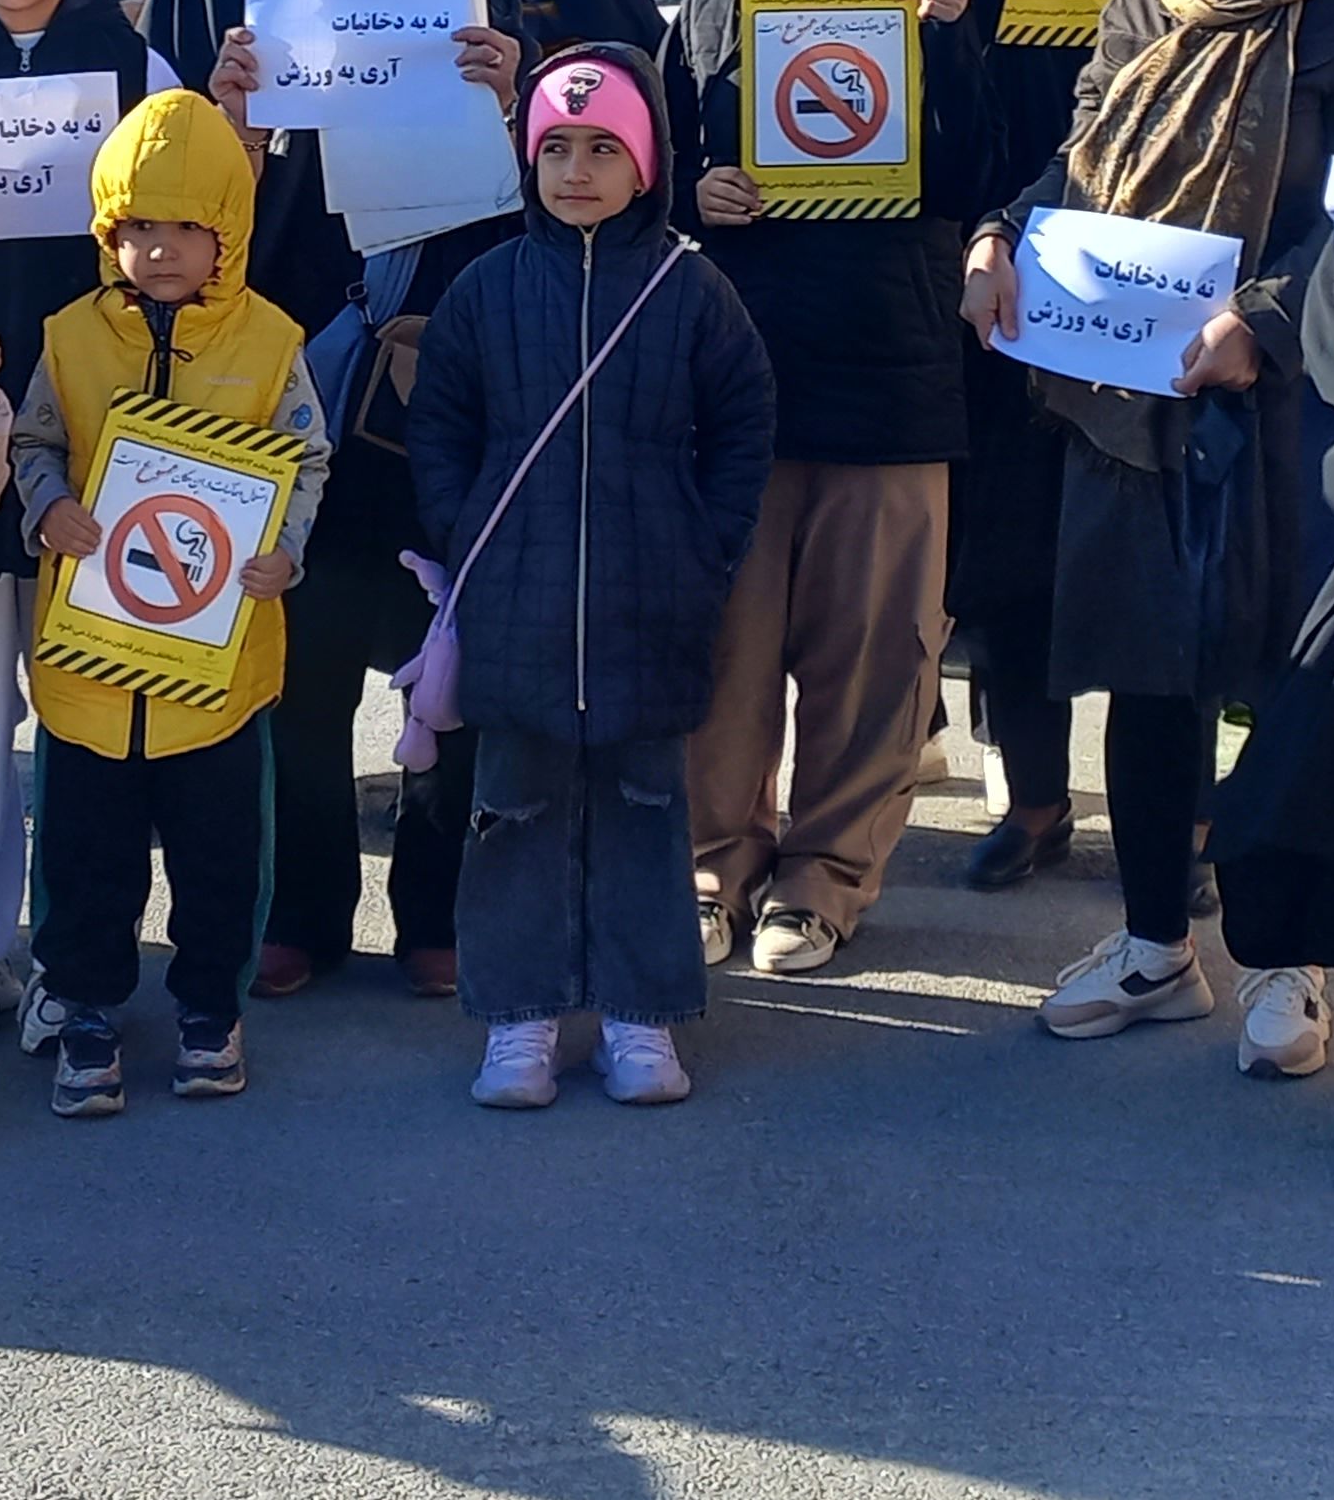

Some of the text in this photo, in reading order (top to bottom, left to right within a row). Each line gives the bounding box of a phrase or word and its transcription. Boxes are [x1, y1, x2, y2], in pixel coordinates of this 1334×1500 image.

[331, 11, 450, 36] نه به دخانیات
[781, 14, 817, 45] ممنوع
[275, 56, 404, 88] آری به ورزش
[61, 119, 80, 141] به
[84, 112, 102, 134] نه
[13, 165, 54, 195] آری
[1094, 260, 1216, 301] نه به دخانیات
[1027, 300, 1159, 344] آری به ورزش
[136, 456, 178, 484] ممنوع
